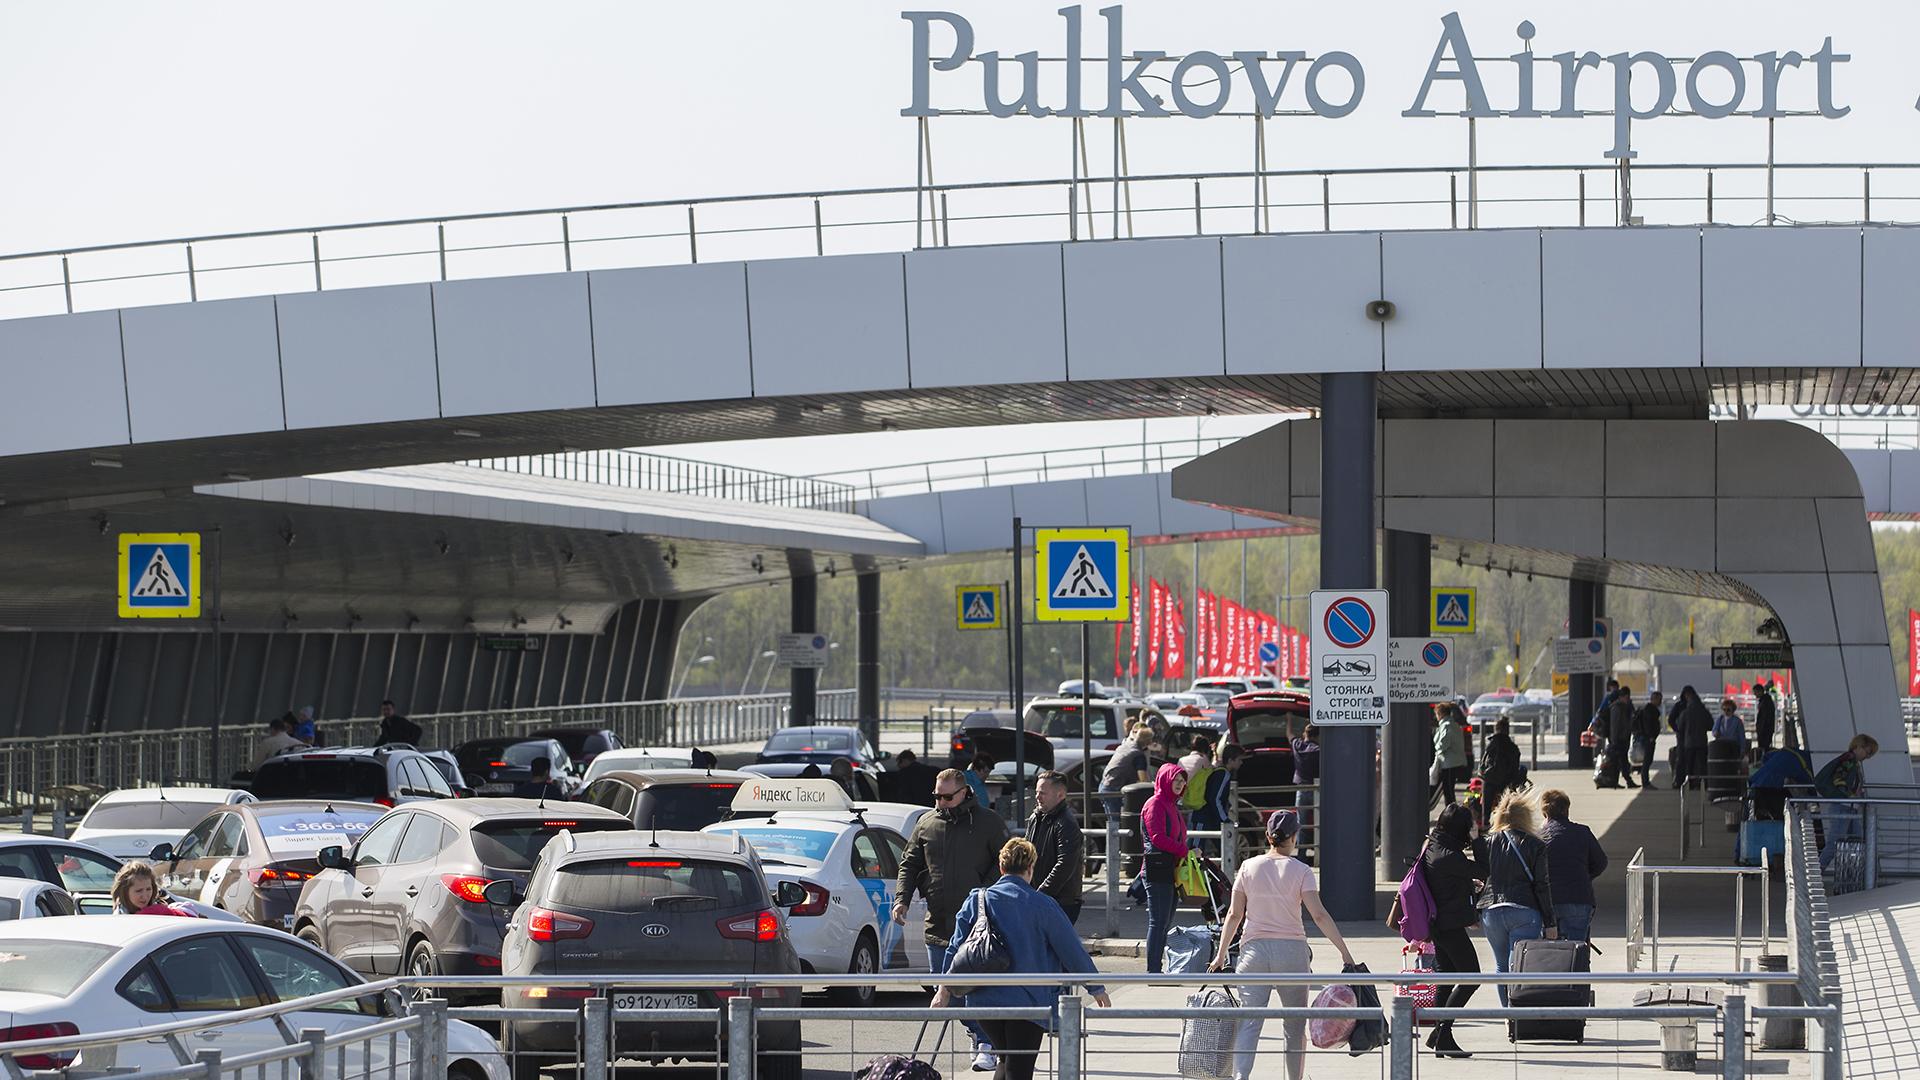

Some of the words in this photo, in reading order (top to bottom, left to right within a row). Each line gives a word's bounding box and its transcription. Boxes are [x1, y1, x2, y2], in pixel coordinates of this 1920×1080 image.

[900, 5, 1365, 119] Pulkovo
[1401, 10, 1852, 158] Airport
[1325, 685, 1374, 695] СТОЯНКА
[753, 784, 792, 802] Яндекс
[795, 786, 826, 802] Такси
[646, 927, 665, 935] KIA
[675, 995, 694, 1006] 178
